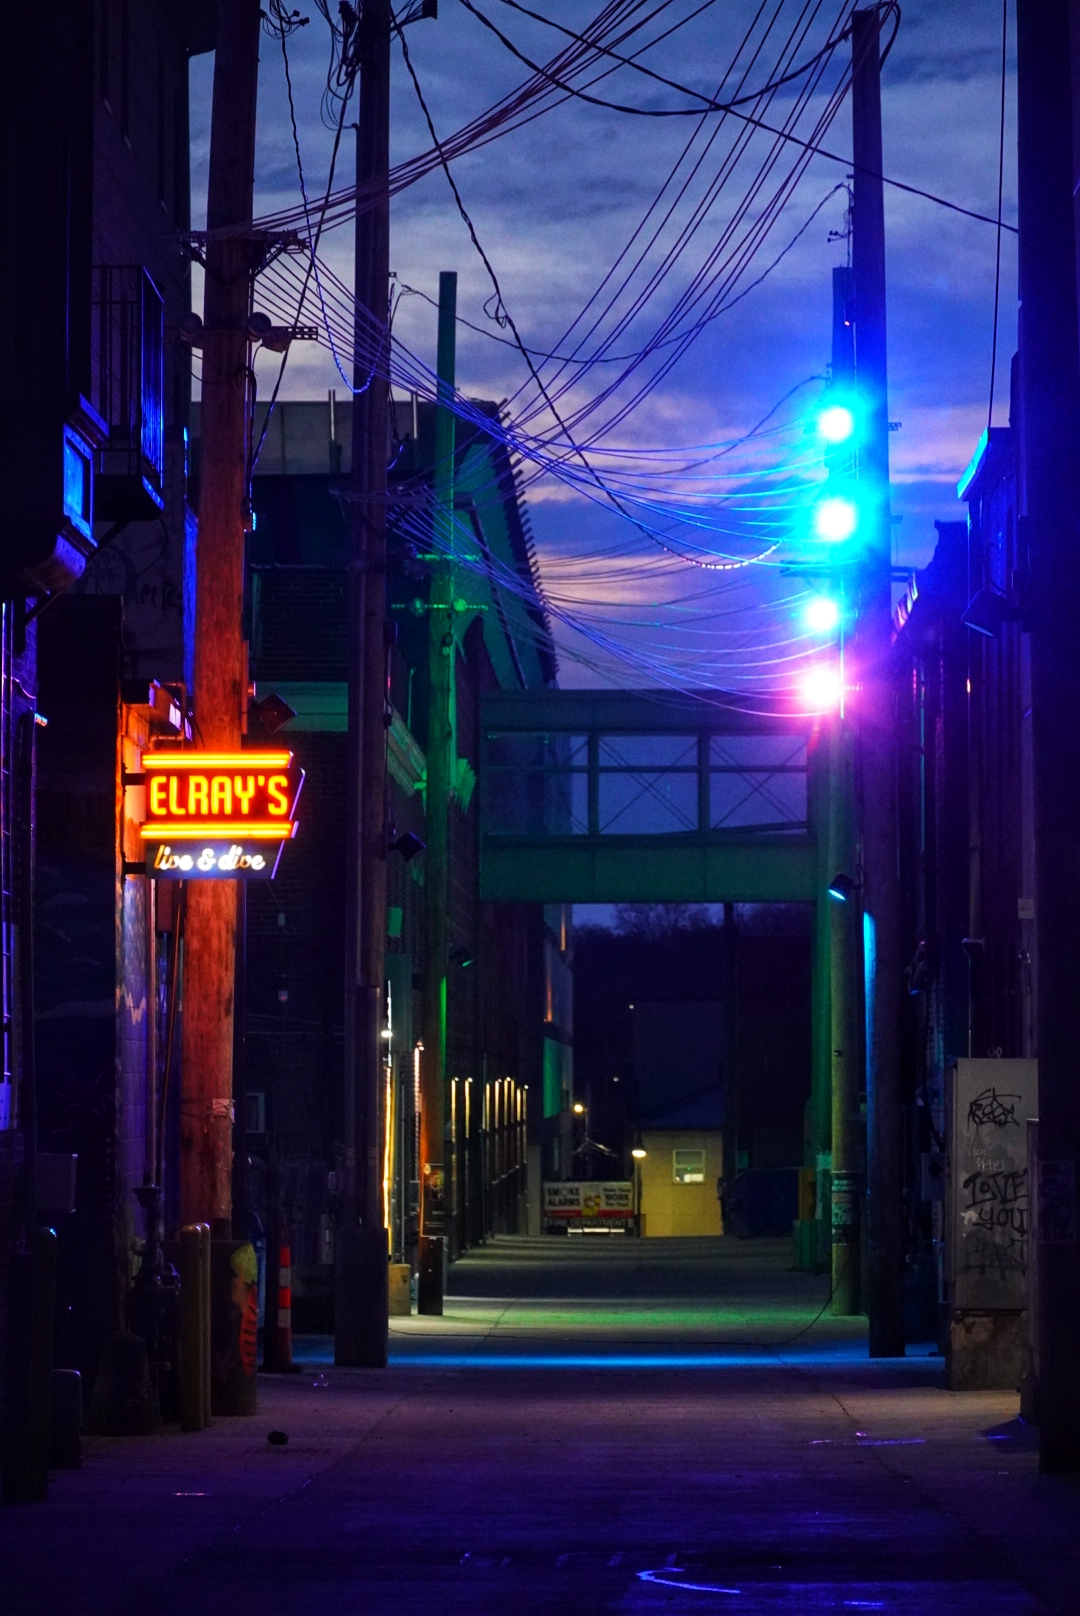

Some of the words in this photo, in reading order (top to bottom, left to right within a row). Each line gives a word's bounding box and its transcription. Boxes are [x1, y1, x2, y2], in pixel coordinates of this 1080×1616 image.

[150, 775, 289, 816] ELRAY'S
[153, 844, 194, 871] live
[196, 847, 217, 872] &
[217, 844, 266, 871] dive
[547, 1187, 580, 1196] SMOKE
[548, 1197, 581, 1206] ALARMS
[605, 1193, 630, 1201] WORK
[570, 1218, 628, 1227] DEPARTMENT
